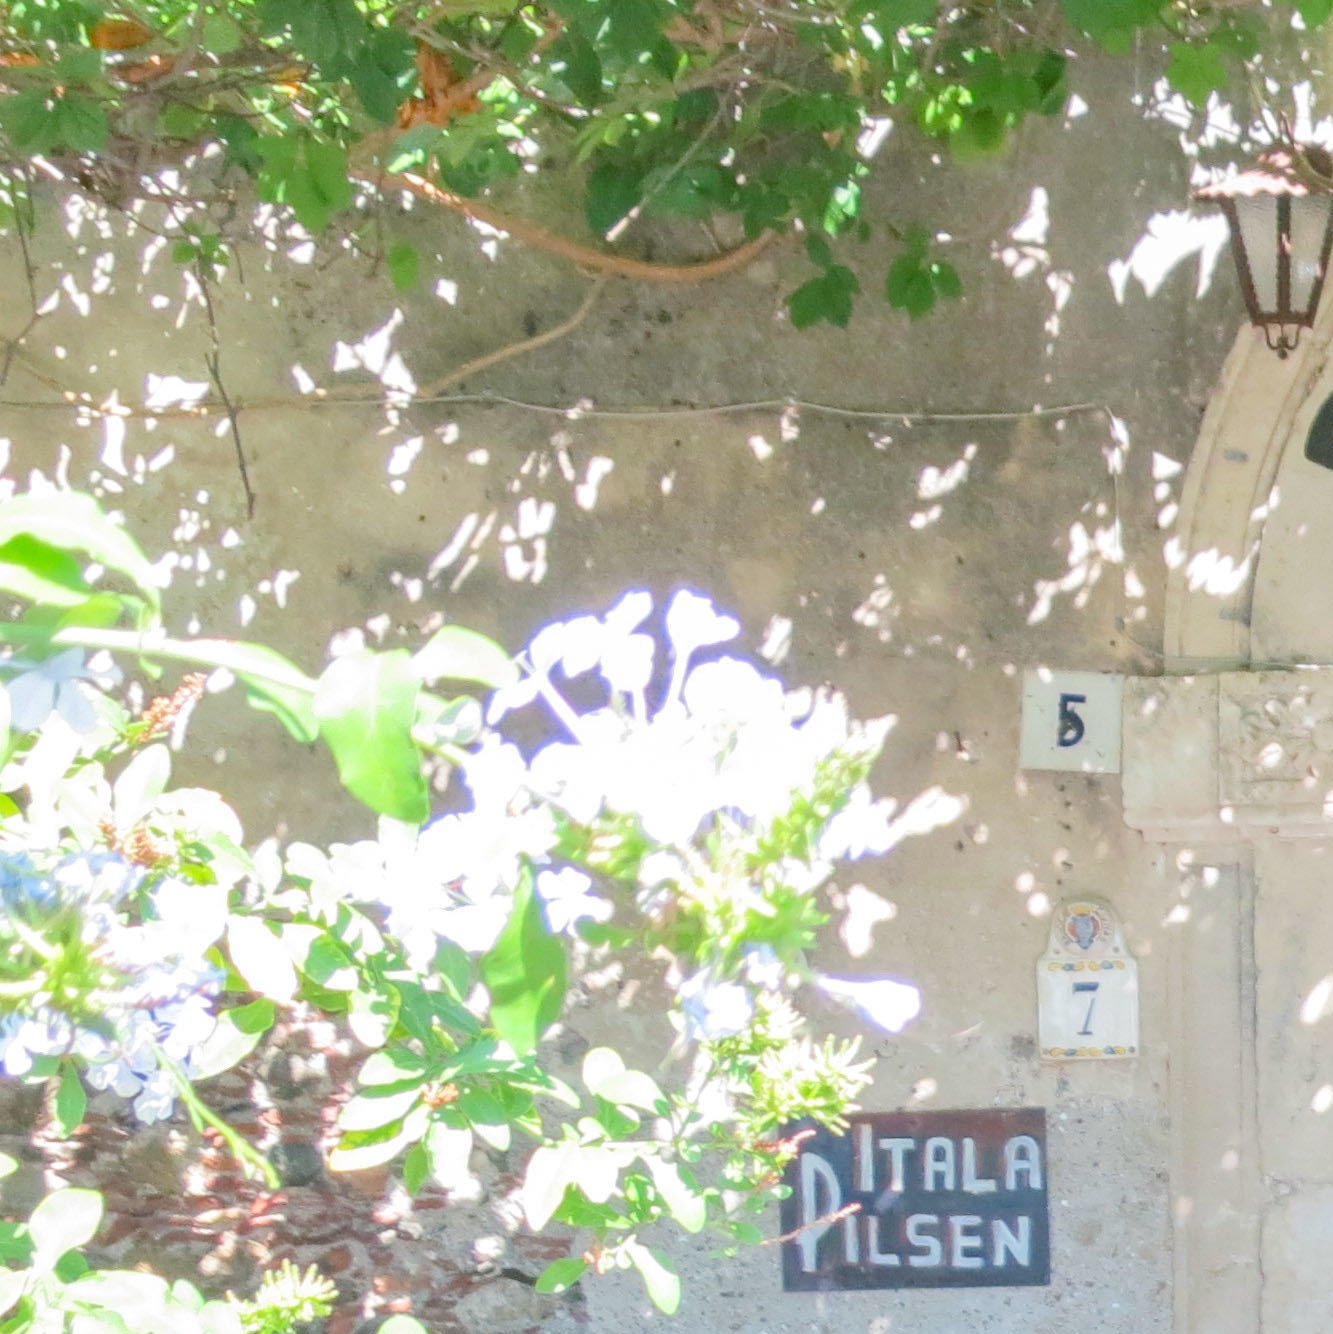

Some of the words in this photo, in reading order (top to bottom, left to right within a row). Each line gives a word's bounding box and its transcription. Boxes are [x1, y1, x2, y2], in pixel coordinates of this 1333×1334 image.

[1057, 692, 1086, 747] 5
[1072, 981, 1100, 1035] 7
[859, 1123, 1043, 1193] ITALA
[795, 1152, 1031, 1273] PILSEN
